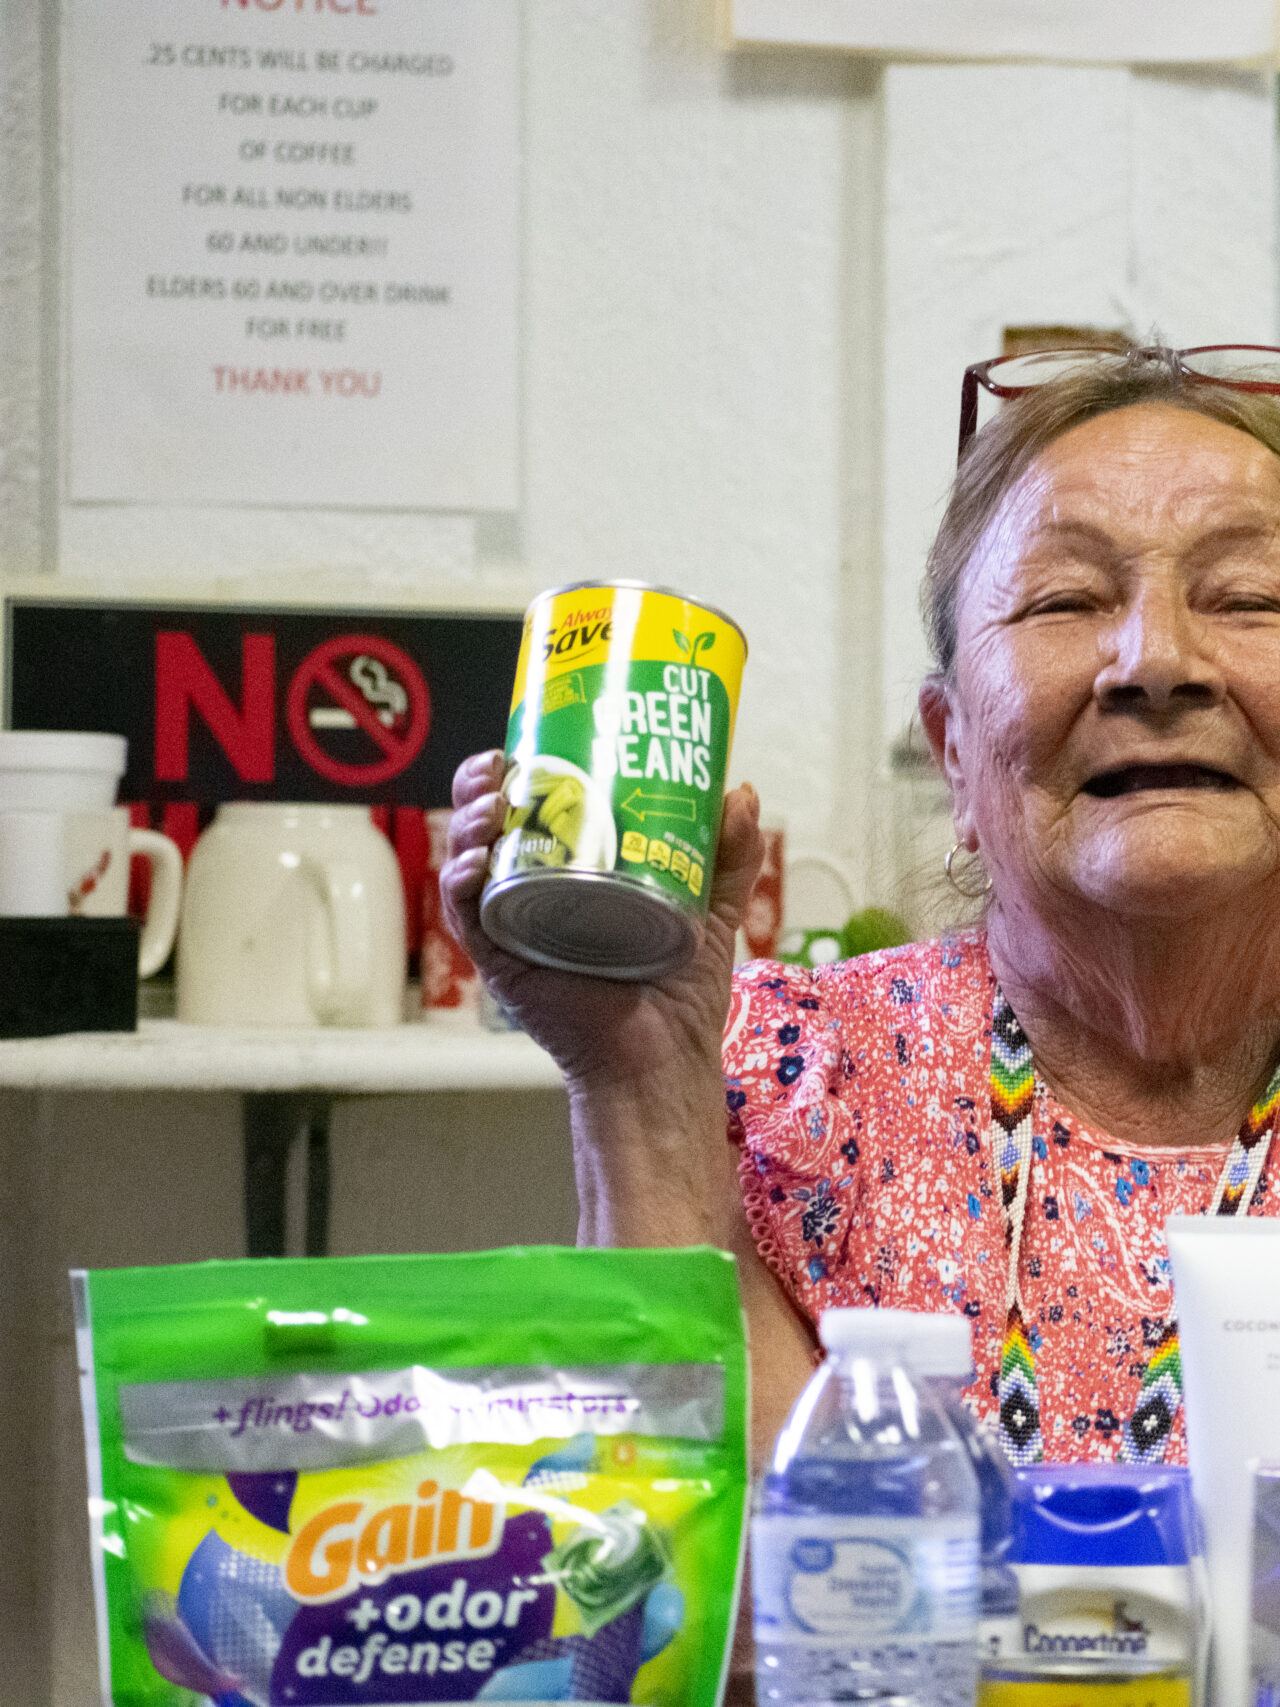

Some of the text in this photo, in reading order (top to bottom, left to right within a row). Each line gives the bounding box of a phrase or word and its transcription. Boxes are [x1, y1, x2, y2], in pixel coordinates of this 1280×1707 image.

[181, 45, 252, 70] CENTS
[257, 49, 308, 73] WILL
[314, 51, 341, 73] BE
[346, 51, 454, 77] CHARGED
[218, 94, 379, 119] FOR EACH CUP
[238, 140, 356, 166] OF COFFEE
[182, 184, 412, 213] FOR ALL NON ELDERS
[206, 231, 235, 254] 60
[240, 233, 289, 255] AND
[145, 275, 453, 305] ELDERS 60 AND OVER DRINK
[245, 317, 347, 343] FOR FREE
[211, 365, 383, 398] THANK YOU
[663, 664, 711, 697] CUT
[287, 1480, 498, 1602] Gain
[297, 1637, 496, 1683] defense
